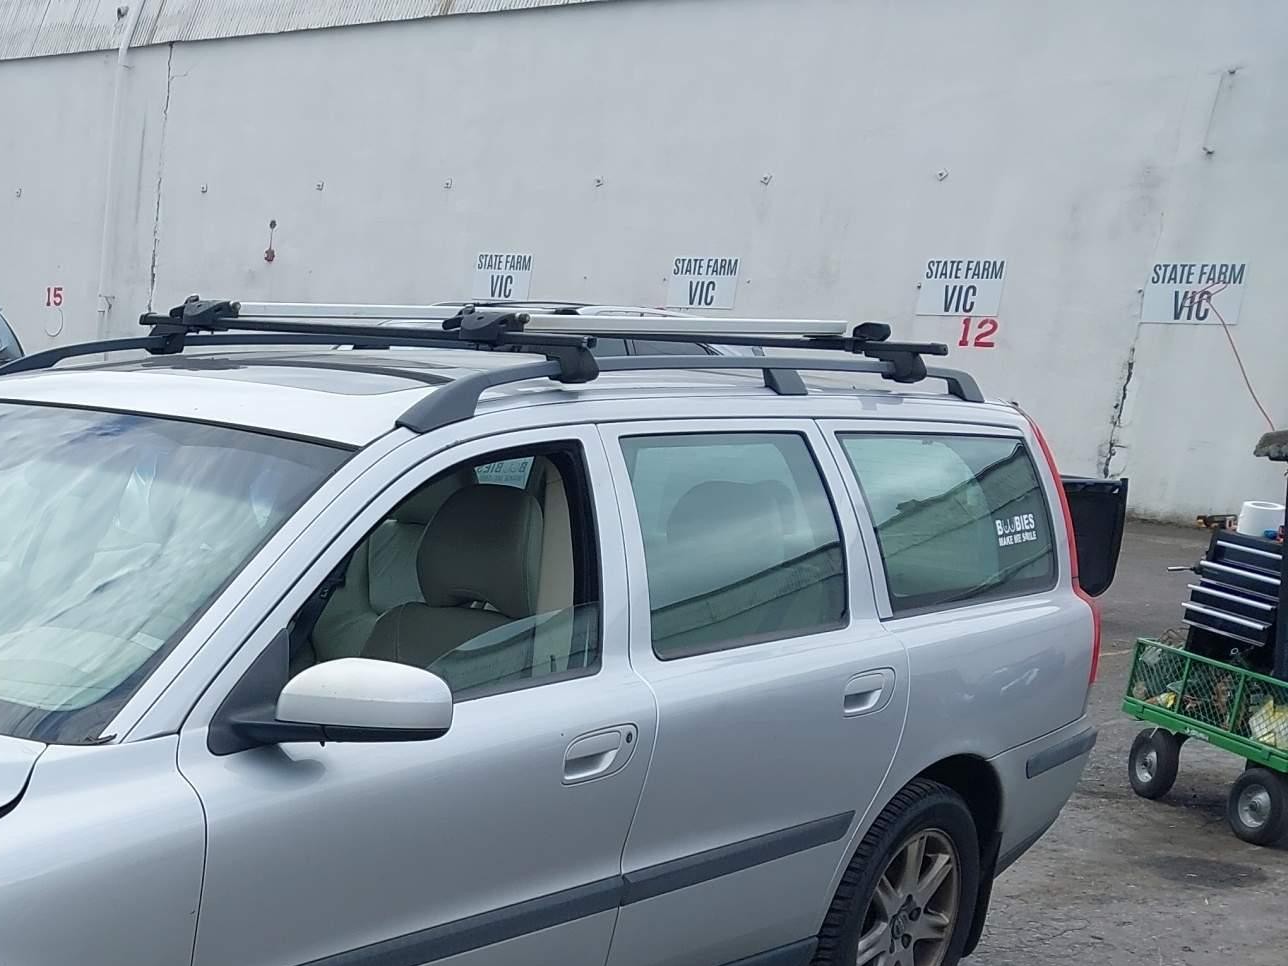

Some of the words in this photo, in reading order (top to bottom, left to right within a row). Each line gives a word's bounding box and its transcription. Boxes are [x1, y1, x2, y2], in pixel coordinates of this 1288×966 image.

[477, 254, 503, 270] STATE
[504, 255, 532, 272] FARM
[673, 258, 704, 276] STATE
[706, 259, 739, 276] FARM
[925, 260, 962, 279] STATE
[964, 261, 1005, 280] FARM
[1151, 264, 1197, 284] STATE
[1199, 264, 1246, 284] FARM
[46, 287, 63, 306] 15
[490, 274, 513, 298] VIC
[688, 280, 716, 306] VIC
[943, 285, 977, 313] VIC
[1173, 290, 1212, 321] VIC
[958, 317, 999, 348] 12
